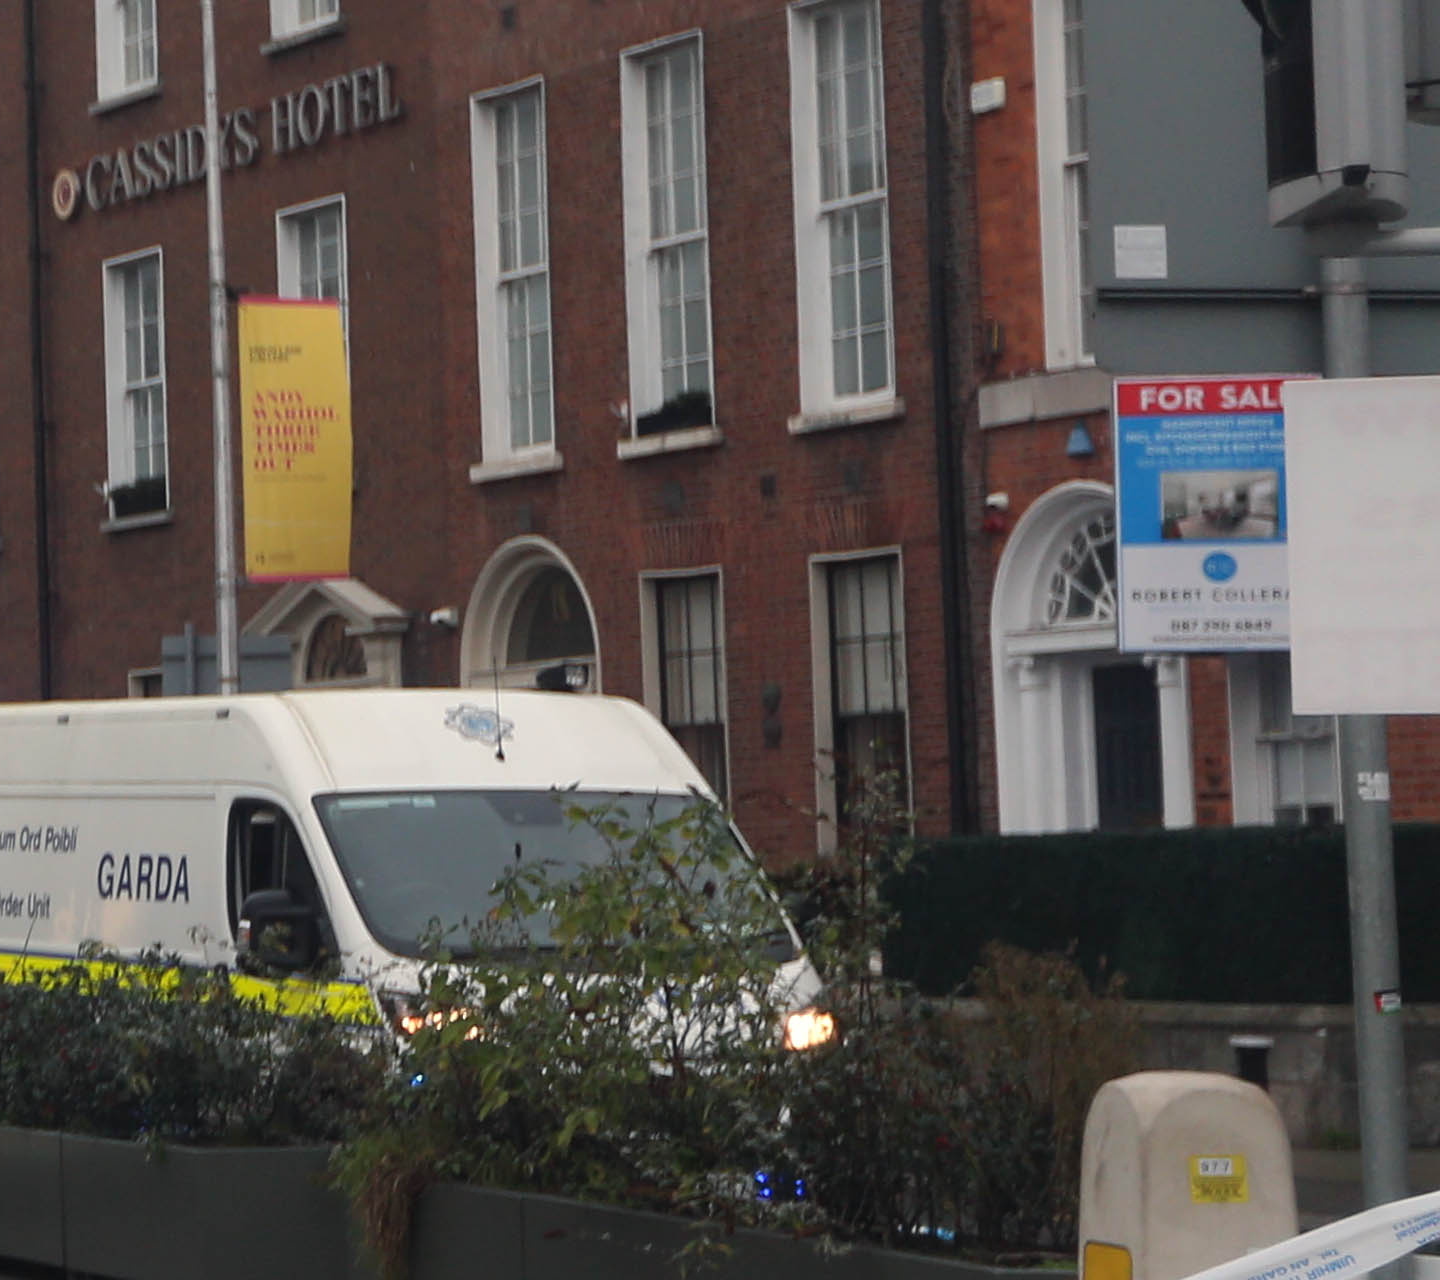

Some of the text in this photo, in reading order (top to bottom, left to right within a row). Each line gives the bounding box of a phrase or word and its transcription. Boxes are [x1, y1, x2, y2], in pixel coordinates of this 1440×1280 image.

[270, 63, 401, 155] HOTEL
[1140, 386, 1205, 411] FOR
[1212, 587, 1290, 603] COLLER
[20, 825, 41, 853] Ord
[97, 853, 190, 904] GARDA
[28, 893, 51, 920] Unit
[1289, 1258, 1310, 1271] AN
